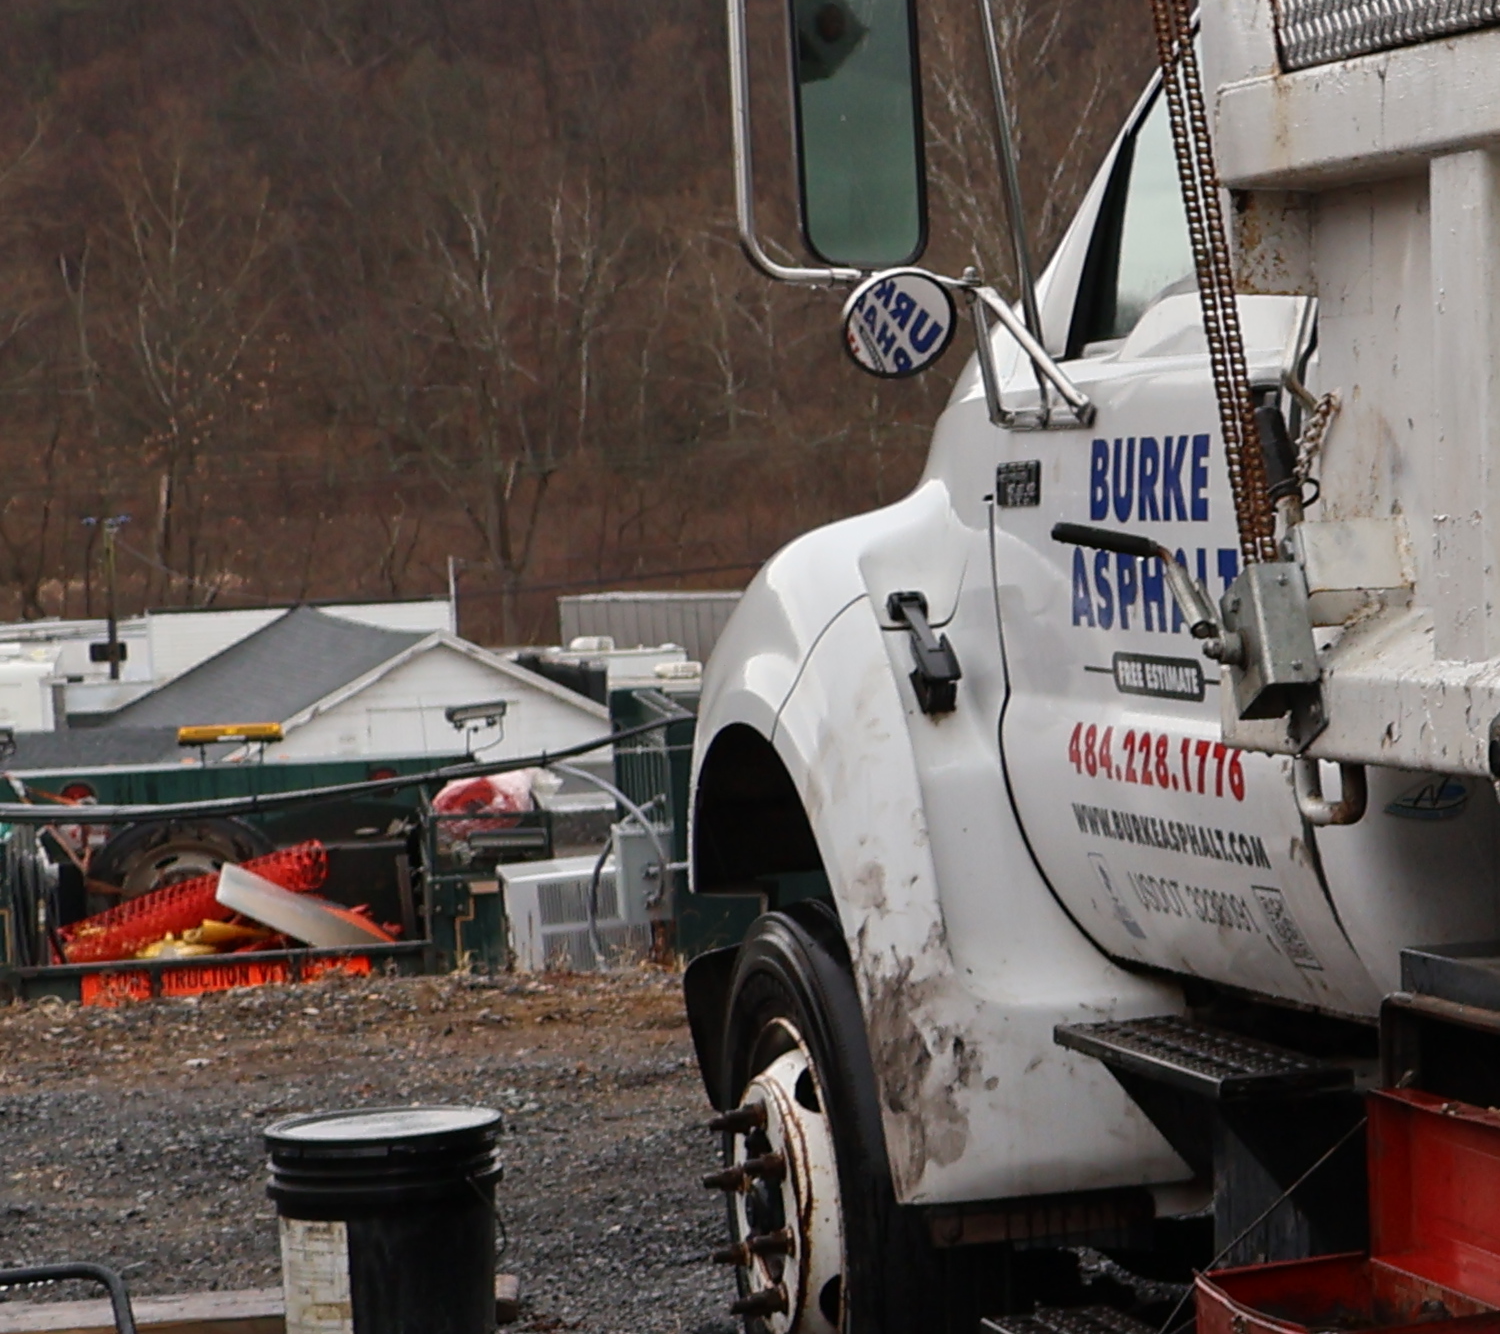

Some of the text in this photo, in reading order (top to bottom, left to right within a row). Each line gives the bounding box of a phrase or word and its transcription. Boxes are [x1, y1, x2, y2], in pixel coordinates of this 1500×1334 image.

[1090, 434, 1210, 523] BURKE
[1117, 660, 1200, 694] FREE ESTIMATE
[1069, 722, 1245, 801] 484.228.1776
[1072, 803, 1271, 869] WWW.BURKEASPHALT.COM
[1128, 871, 1191, 918] USDOT
